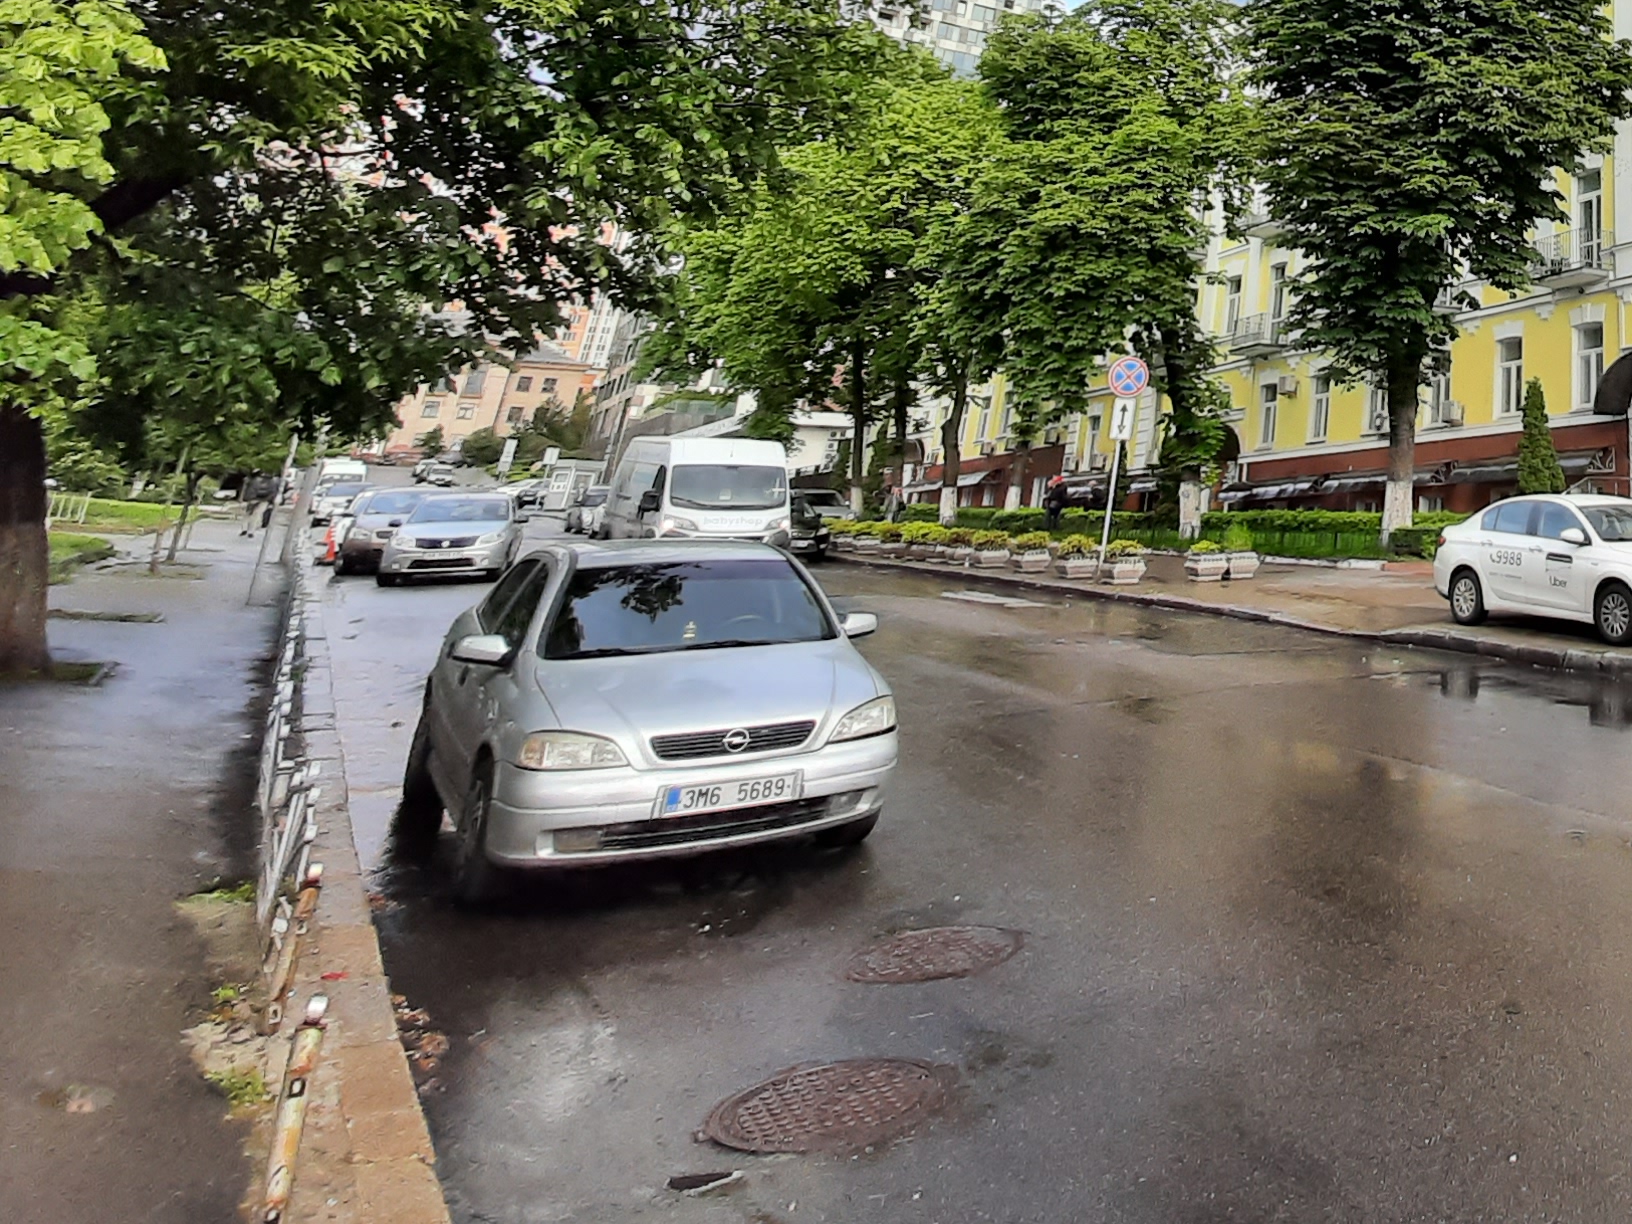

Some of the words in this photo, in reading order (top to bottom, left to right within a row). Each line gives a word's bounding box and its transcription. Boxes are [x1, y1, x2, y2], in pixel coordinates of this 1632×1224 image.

[1496, 551, 1522, 566] 9988
[1549, 575, 1568, 588] Uber
[683, 786, 722, 809] 3M6
[737, 778, 785, 802] 5689
